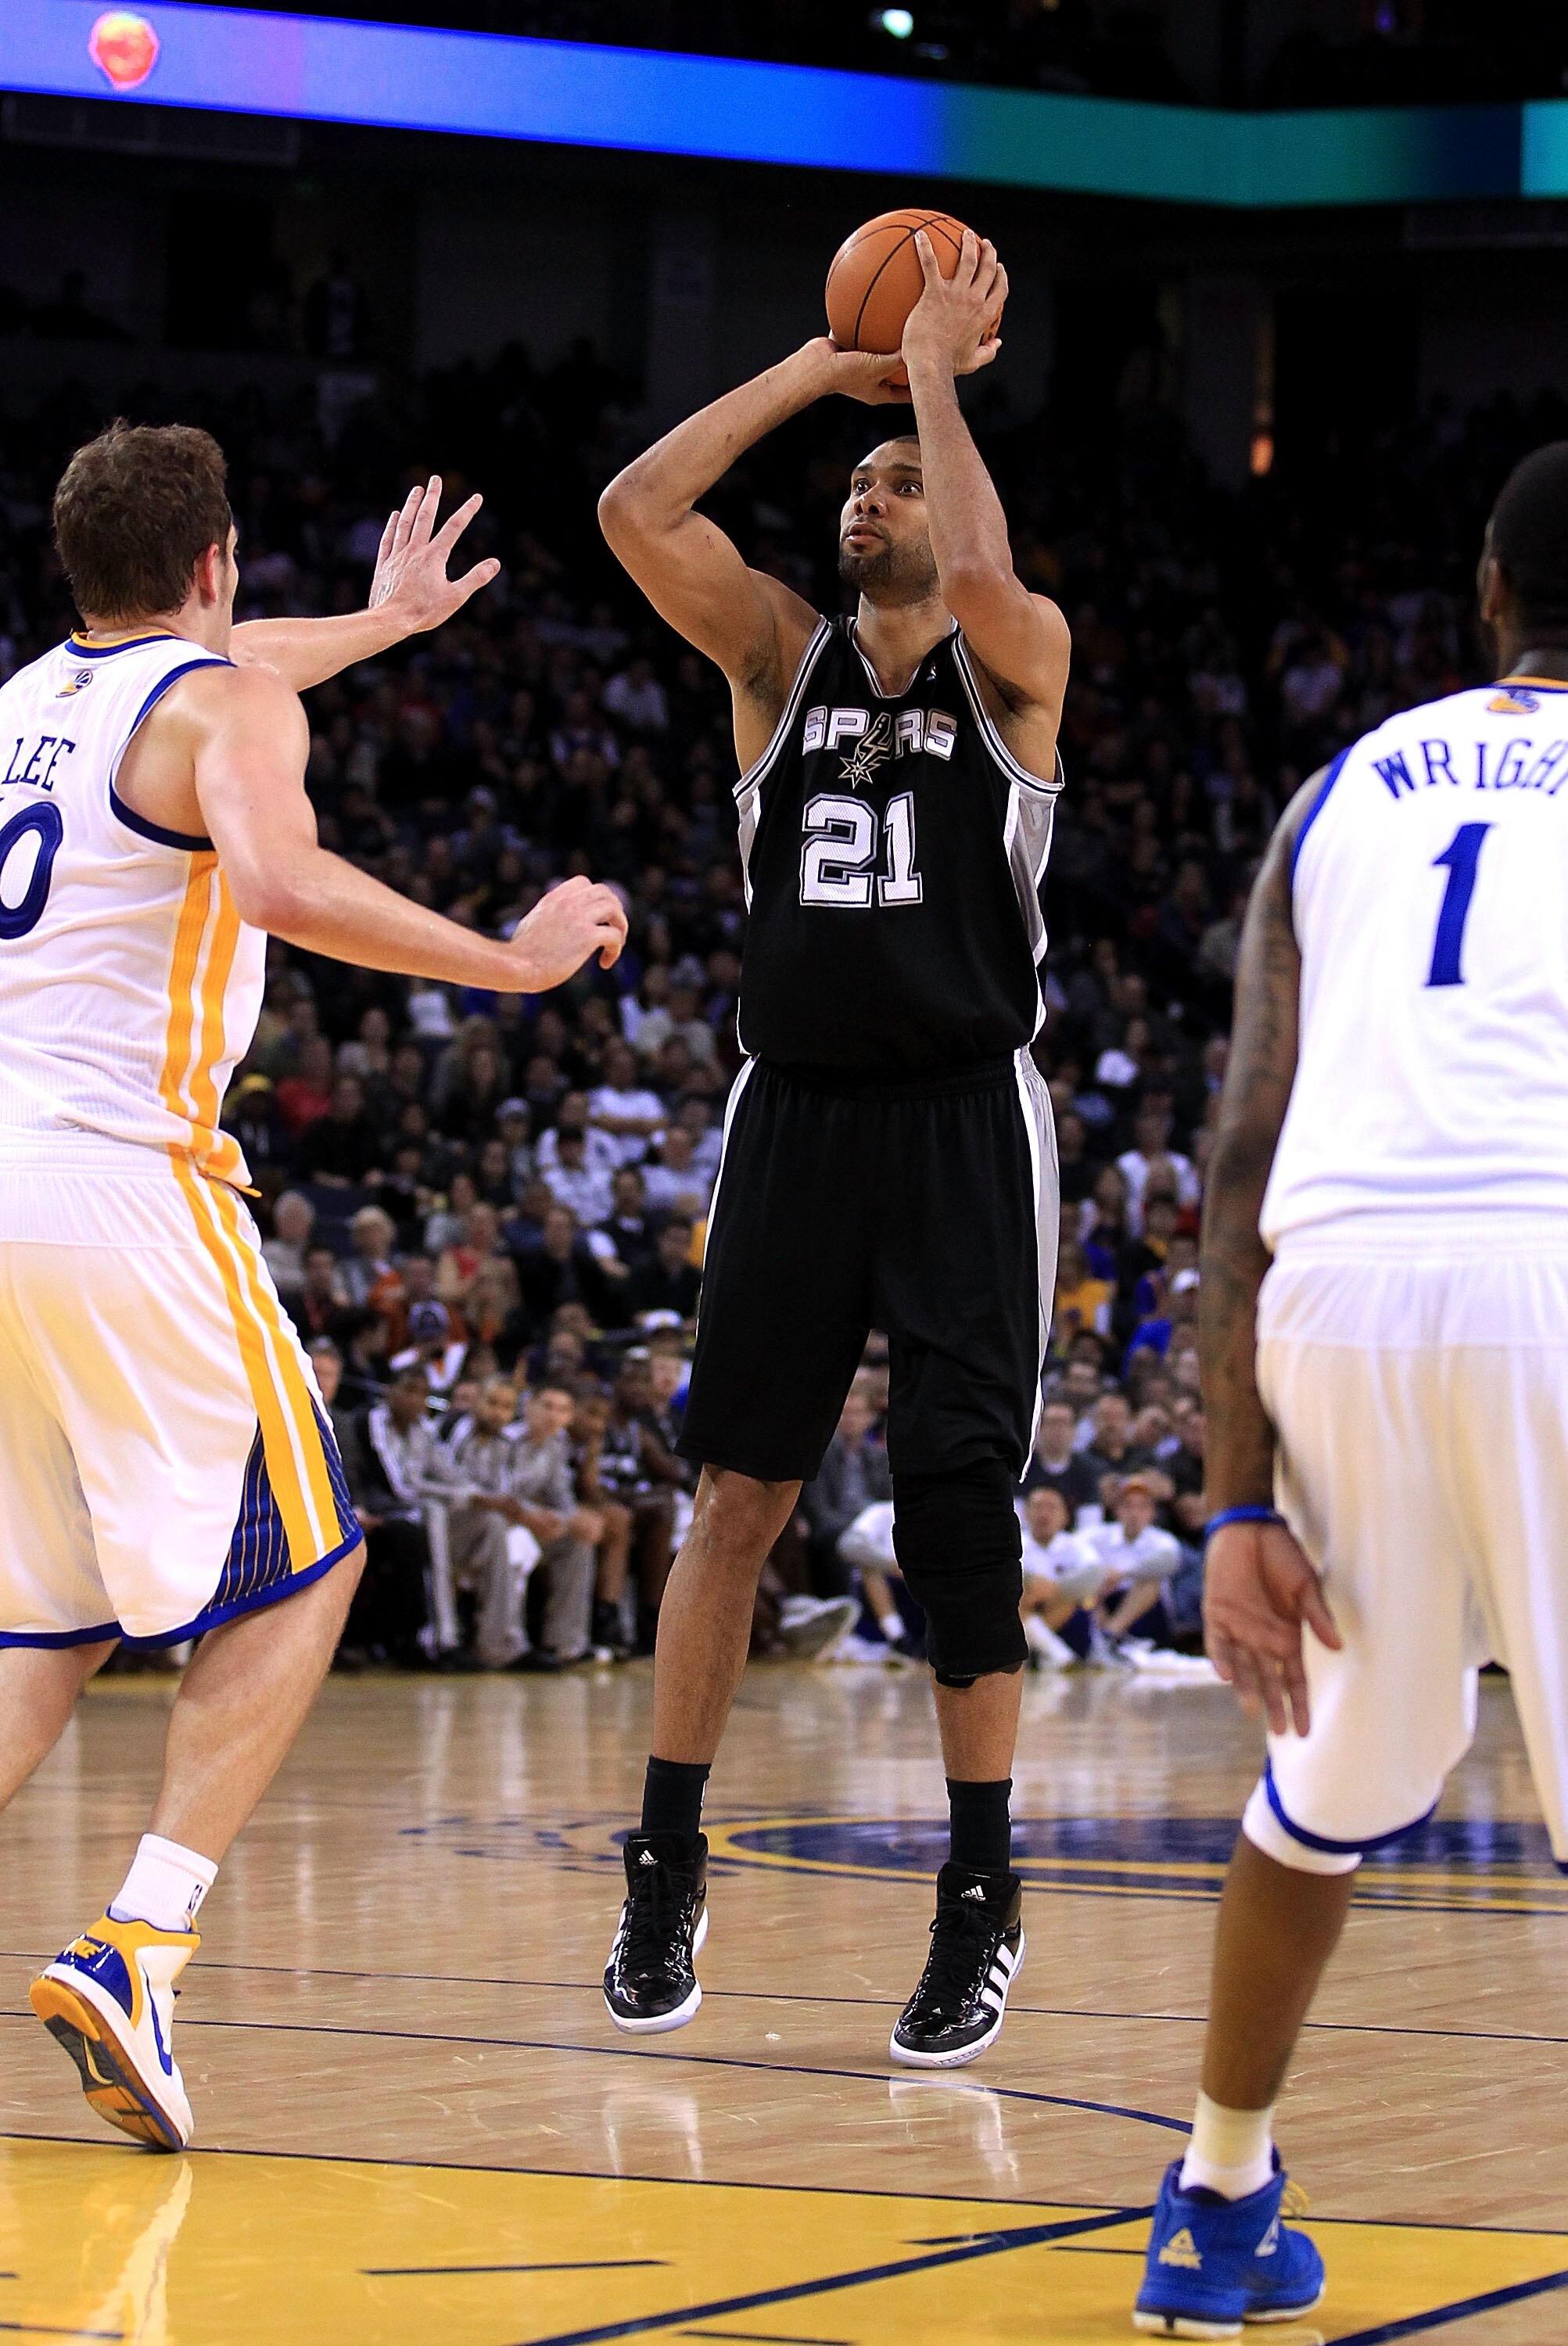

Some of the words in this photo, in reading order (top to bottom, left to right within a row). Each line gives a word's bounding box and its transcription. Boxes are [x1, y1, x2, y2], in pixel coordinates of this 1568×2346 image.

[1, 735, 76, 791] LEE
[0, 796, 63, 938] 0
[799, 791, 923, 908] 21
[1425, 822, 1493, 986] 1
